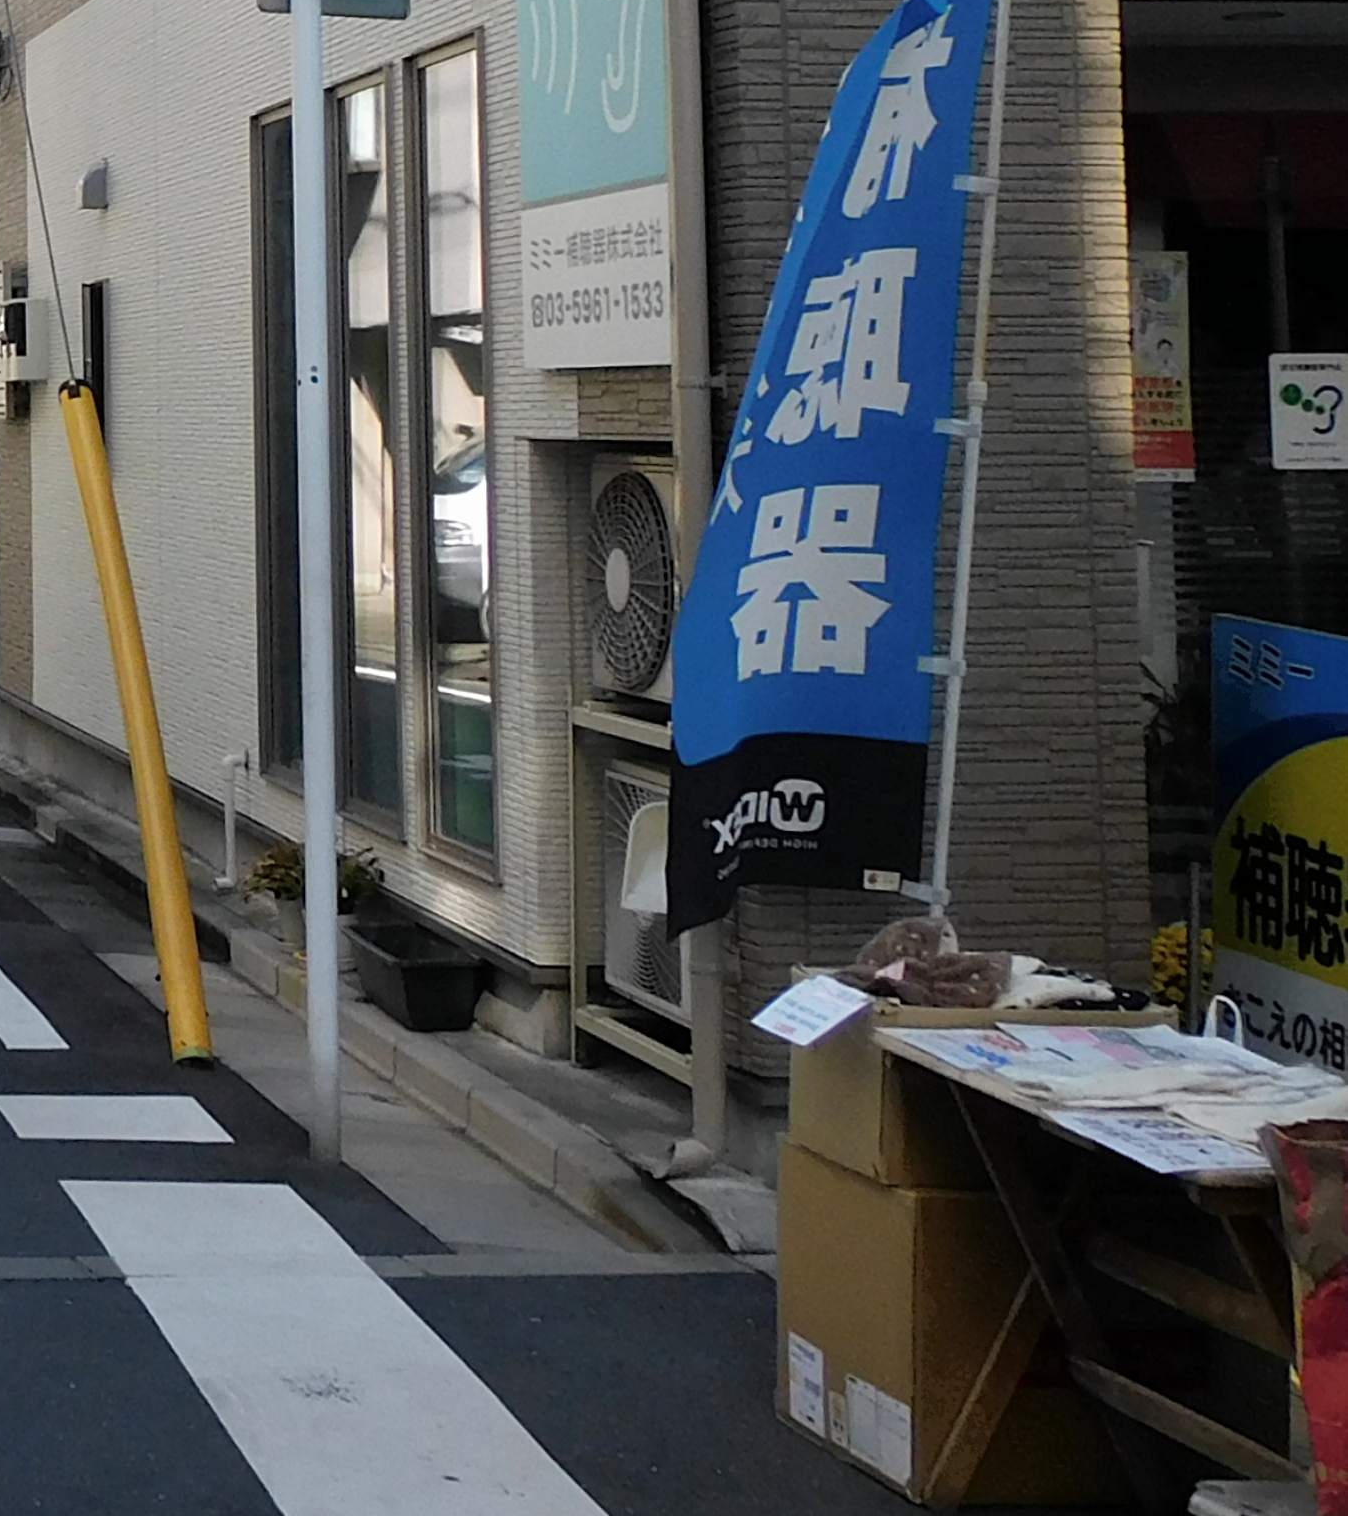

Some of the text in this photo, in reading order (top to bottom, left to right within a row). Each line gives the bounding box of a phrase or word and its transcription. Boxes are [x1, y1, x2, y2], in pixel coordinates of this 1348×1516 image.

[529, 217, 665, 271] ミミー補聴器株式会社
[545, 278, 665, 327] 03-5961-1533
[1226, 633, 1315, 692] ミミー
[1230, 815, 1348, 968] 補聴
